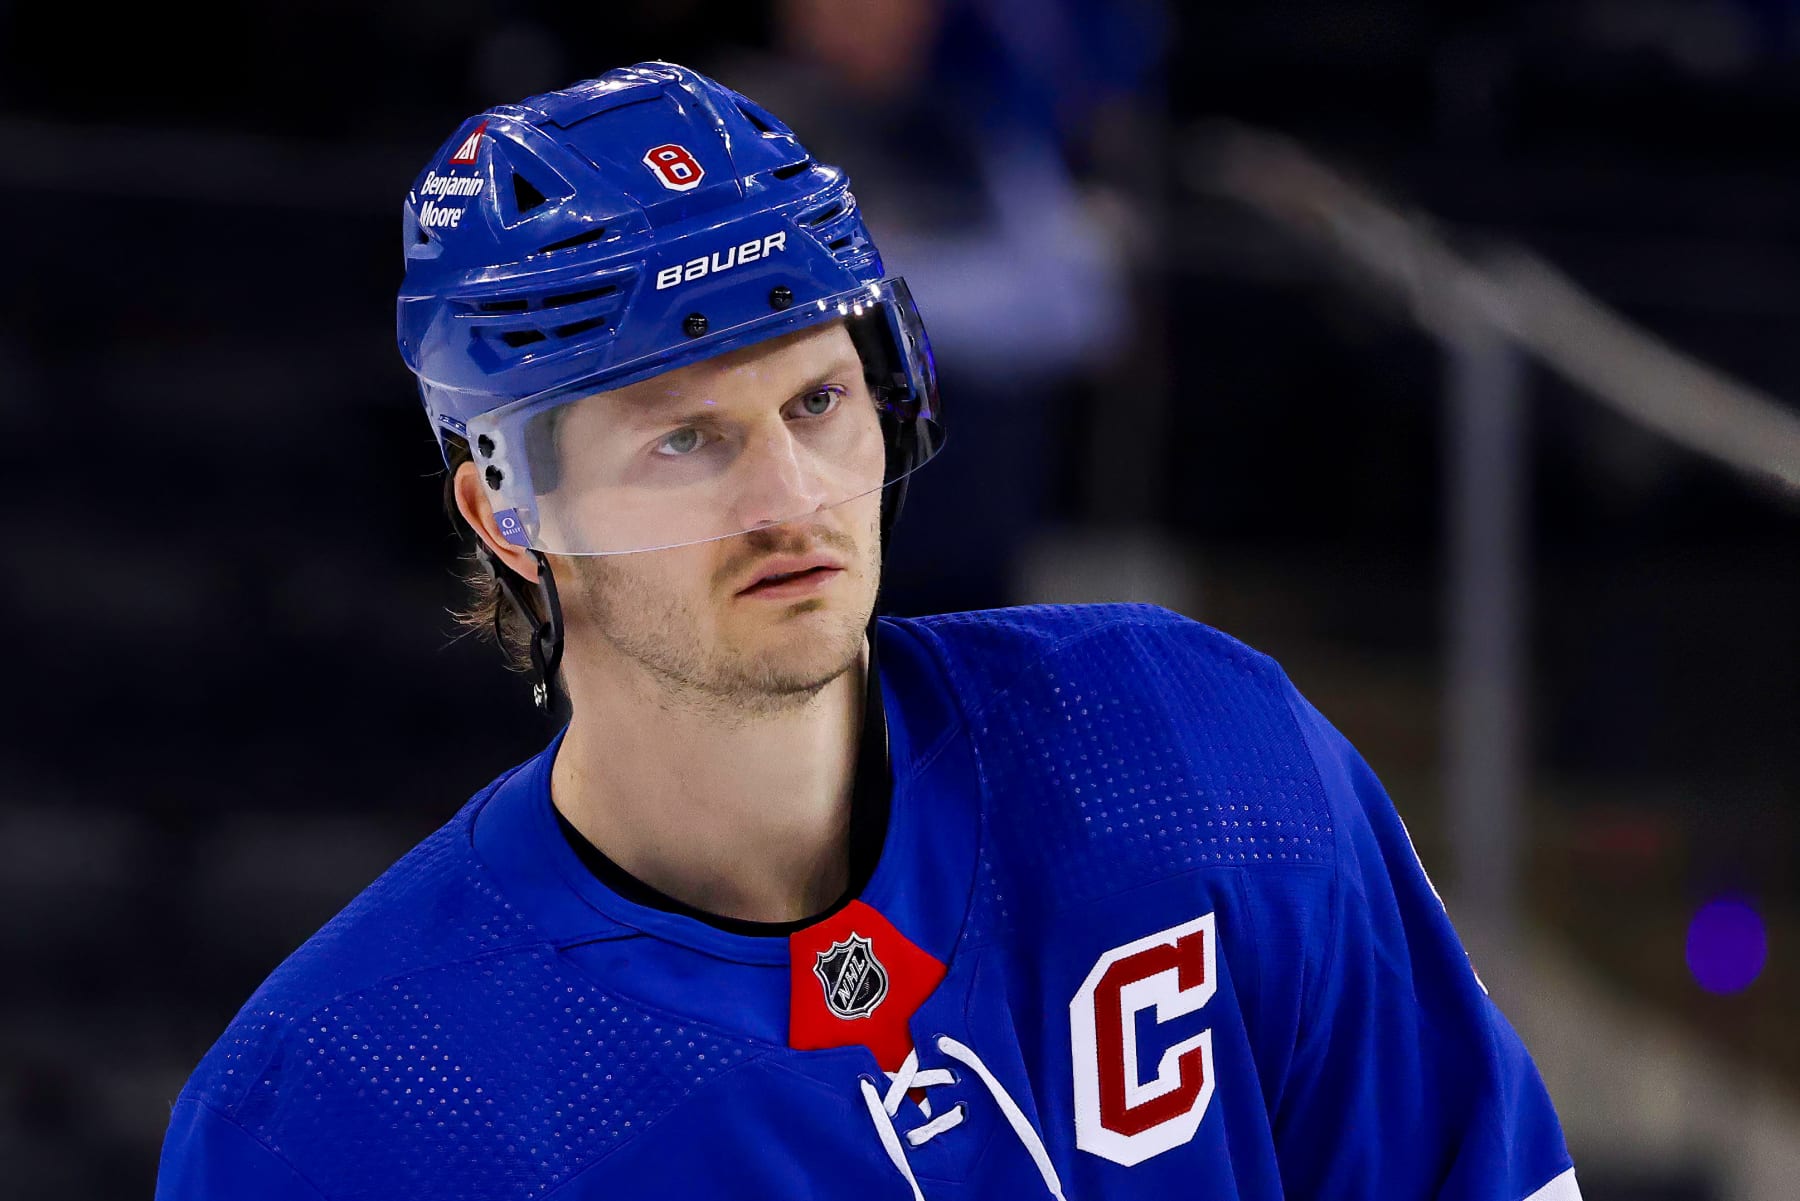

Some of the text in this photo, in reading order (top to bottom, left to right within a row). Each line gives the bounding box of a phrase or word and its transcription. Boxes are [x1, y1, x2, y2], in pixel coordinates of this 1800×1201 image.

[420, 169, 484, 202] Benjamin
[642, 143, 706, 192] 8
[837, 955, 866, 1008] NHL
[1069, 911, 1217, 1167] C
